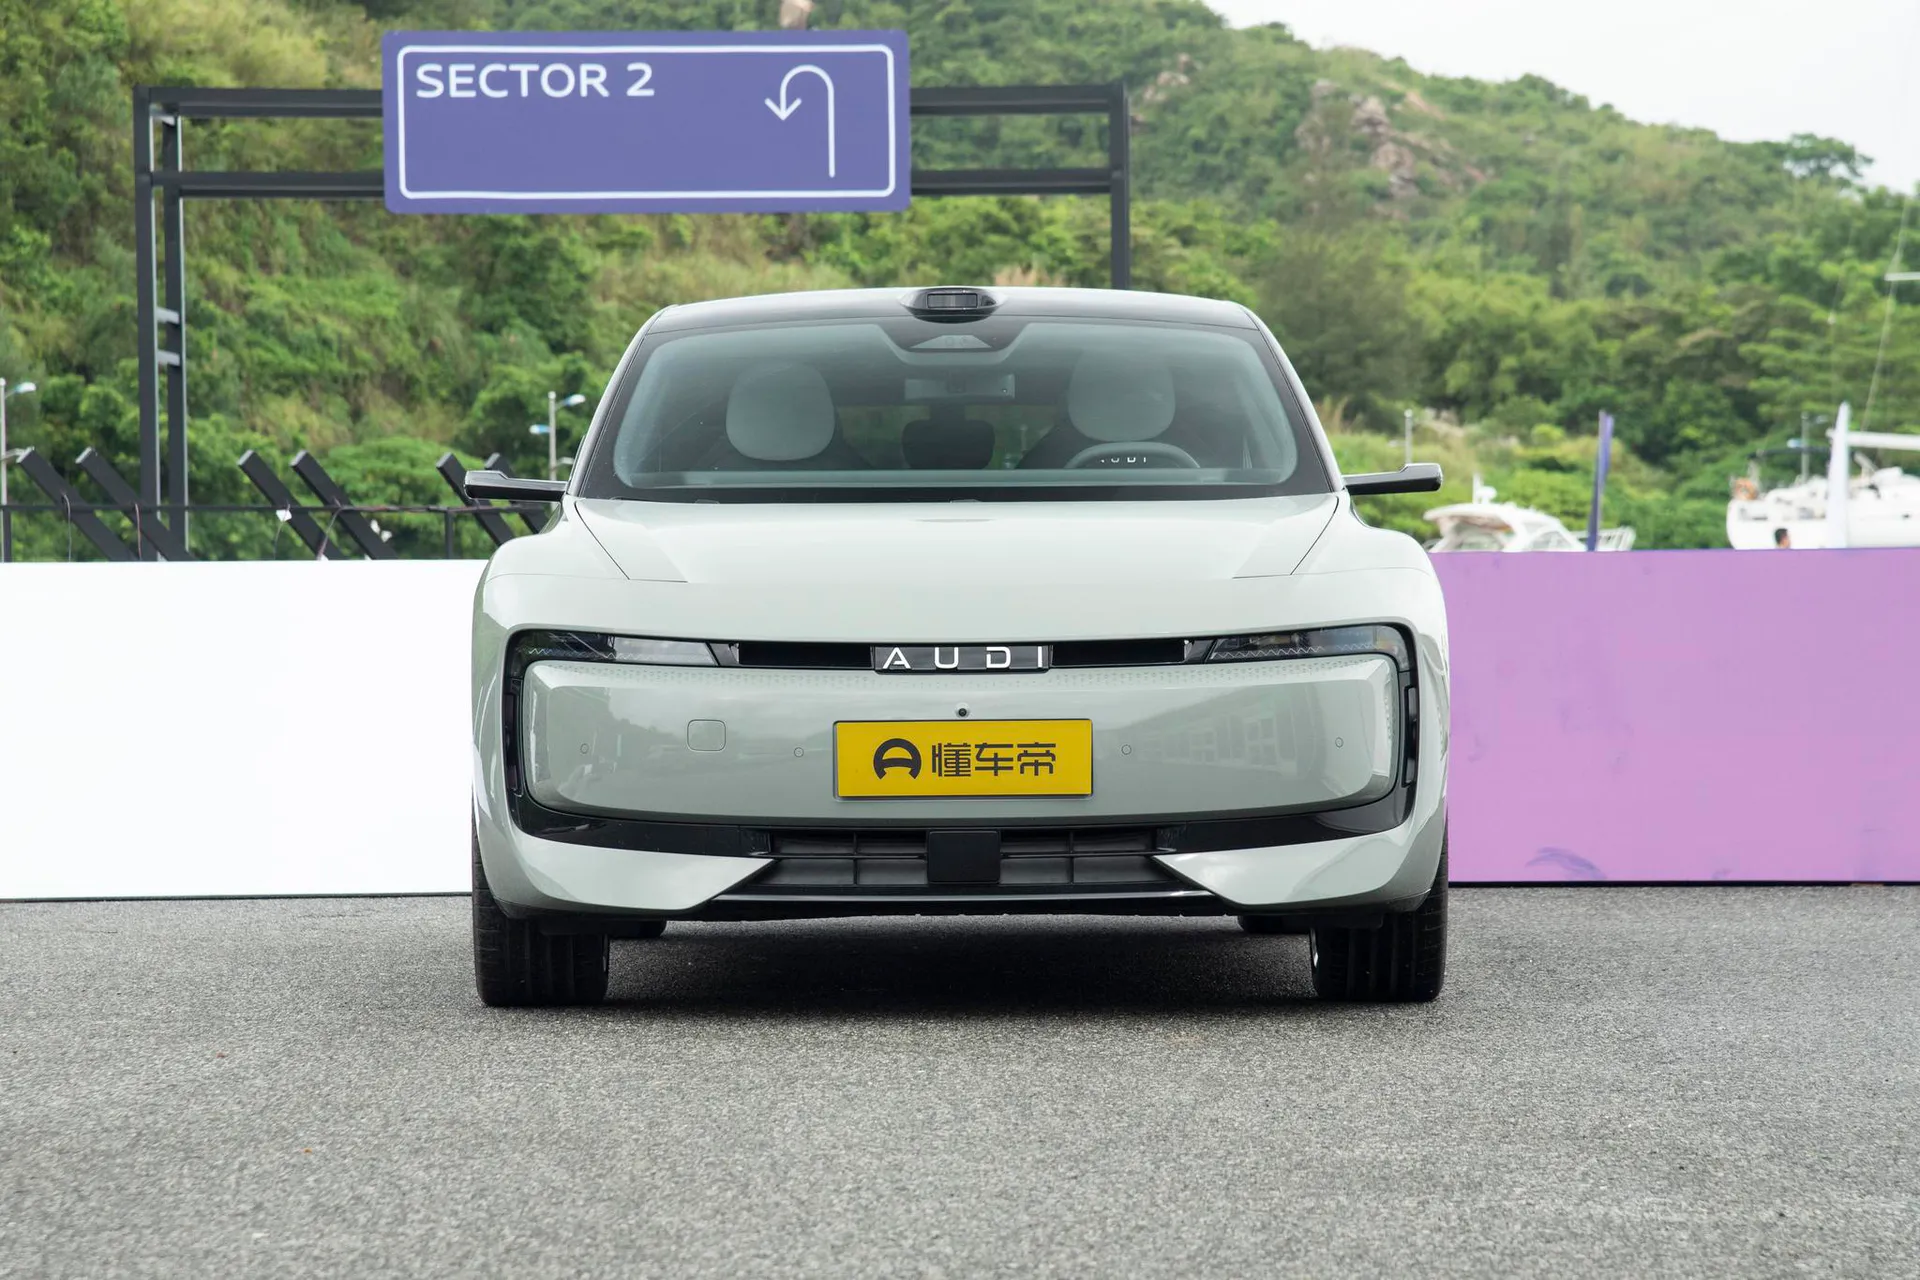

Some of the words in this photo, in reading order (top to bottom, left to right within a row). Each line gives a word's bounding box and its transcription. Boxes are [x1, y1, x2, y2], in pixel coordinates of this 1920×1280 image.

[416, 63, 610, 99] SECTOR
[626, 62, 655, 97] 2
[882, 646, 1043, 669] AUDI
[931, 741, 1057, 778] 懂车帝
